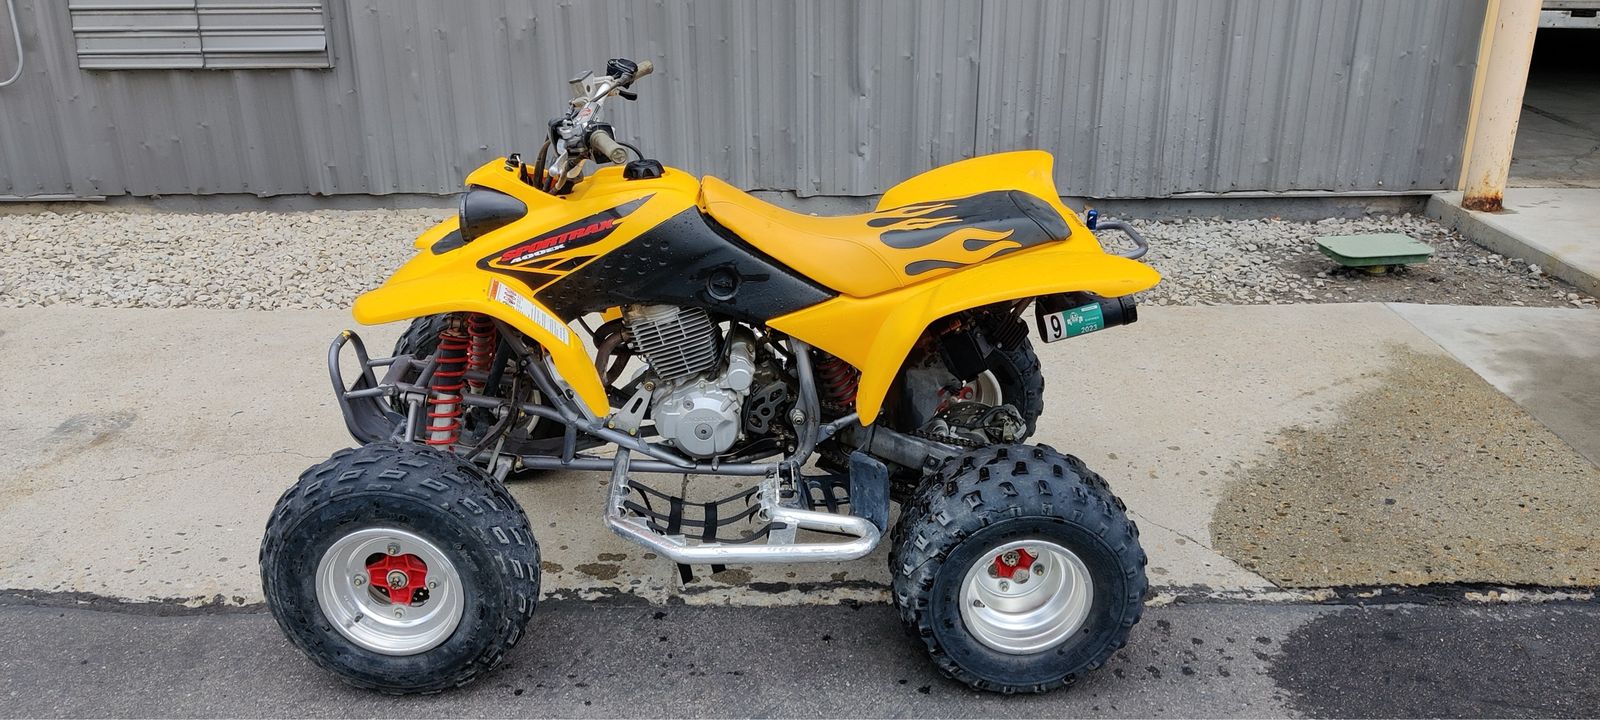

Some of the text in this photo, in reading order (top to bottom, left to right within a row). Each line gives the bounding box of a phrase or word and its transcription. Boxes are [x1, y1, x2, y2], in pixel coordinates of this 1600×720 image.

[501, 218, 614, 262] SPORTRAX
[510, 243, 565, 264] 400EX
[1050, 315, 1062, 338] 9
[1081, 324, 1098, 333] 2023
